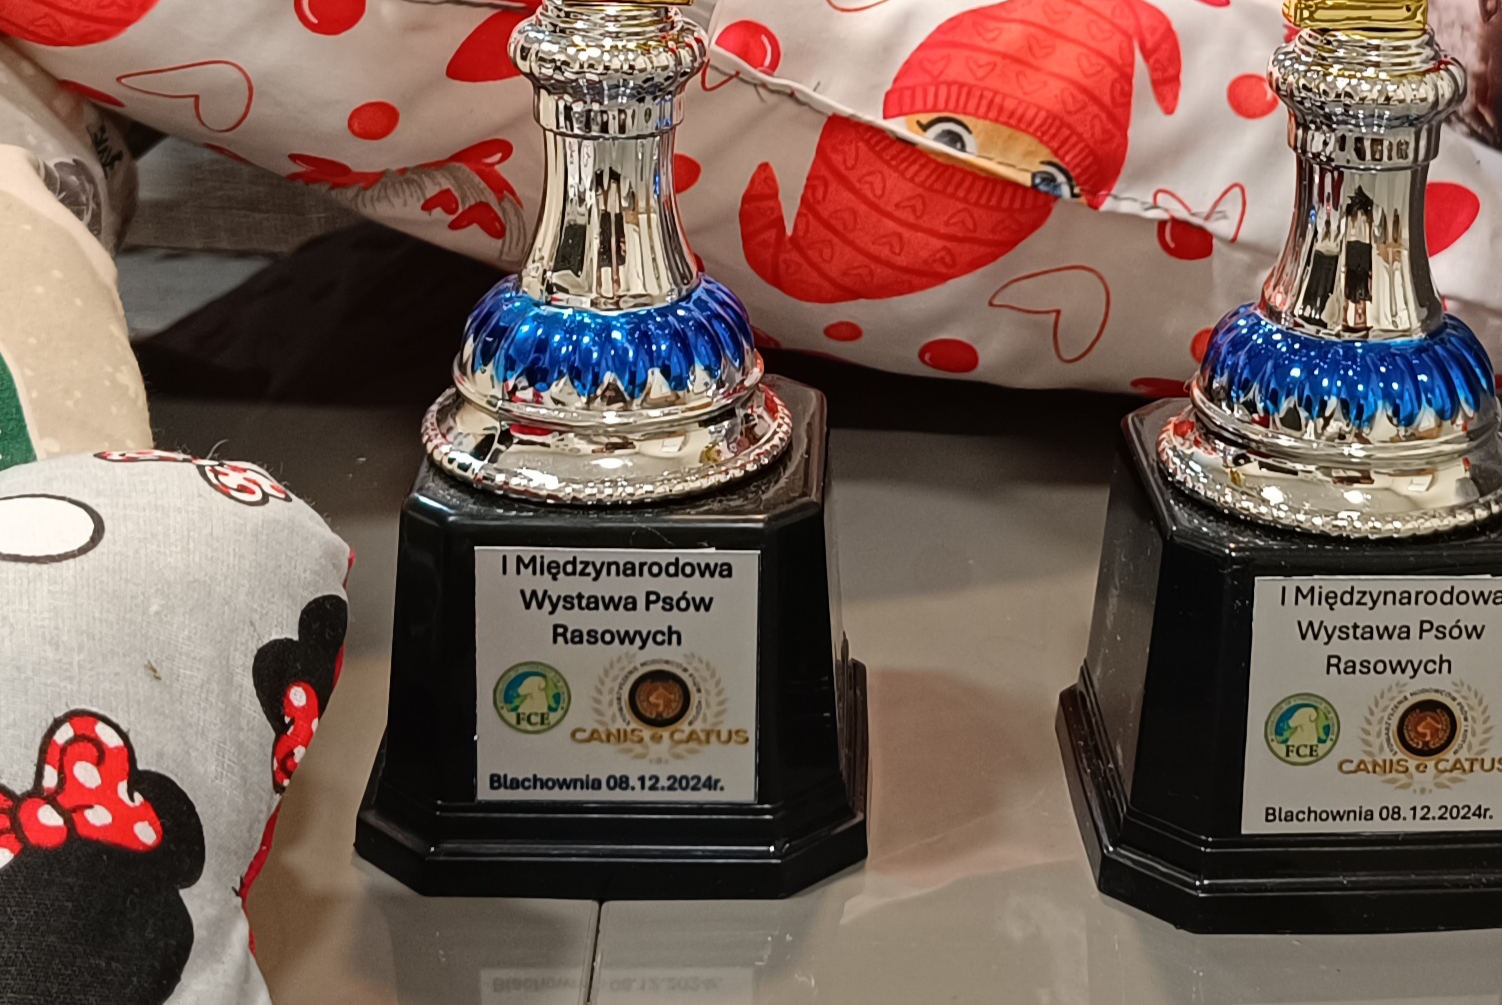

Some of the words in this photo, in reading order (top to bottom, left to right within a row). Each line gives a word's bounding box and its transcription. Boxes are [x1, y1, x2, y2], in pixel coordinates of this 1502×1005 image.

[502, 554, 508, 576] I
[516, 555, 733, 581] Międzynarodowa
[520, 589, 637, 615] Wystawa
[644, 591, 713, 612] Psów
[1280, 586, 1286, 606] I
[552, 624, 682, 650] Rasowych
[1297, 620, 1410, 645] Wystawa
[1418, 620, 1485, 640] Psów
[1326, 654, 1452, 679] Rasowych
[515, 712, 550, 726] FCE
[570, 727, 643, 744] CANIS
[669, 728, 749, 745] CATUS
[1285, 744, 1319, 758] FCE
[1338, 758, 1409, 774] CANIS
[1414, 760, 1428, 774] e
[489, 774, 601, 791] Blachownia
[606, 775, 724, 791] 08.12.2024r.
[1264, 805, 1374, 822] Blachownia
[1379, 805, 1494, 821] 08.12.2024r.
